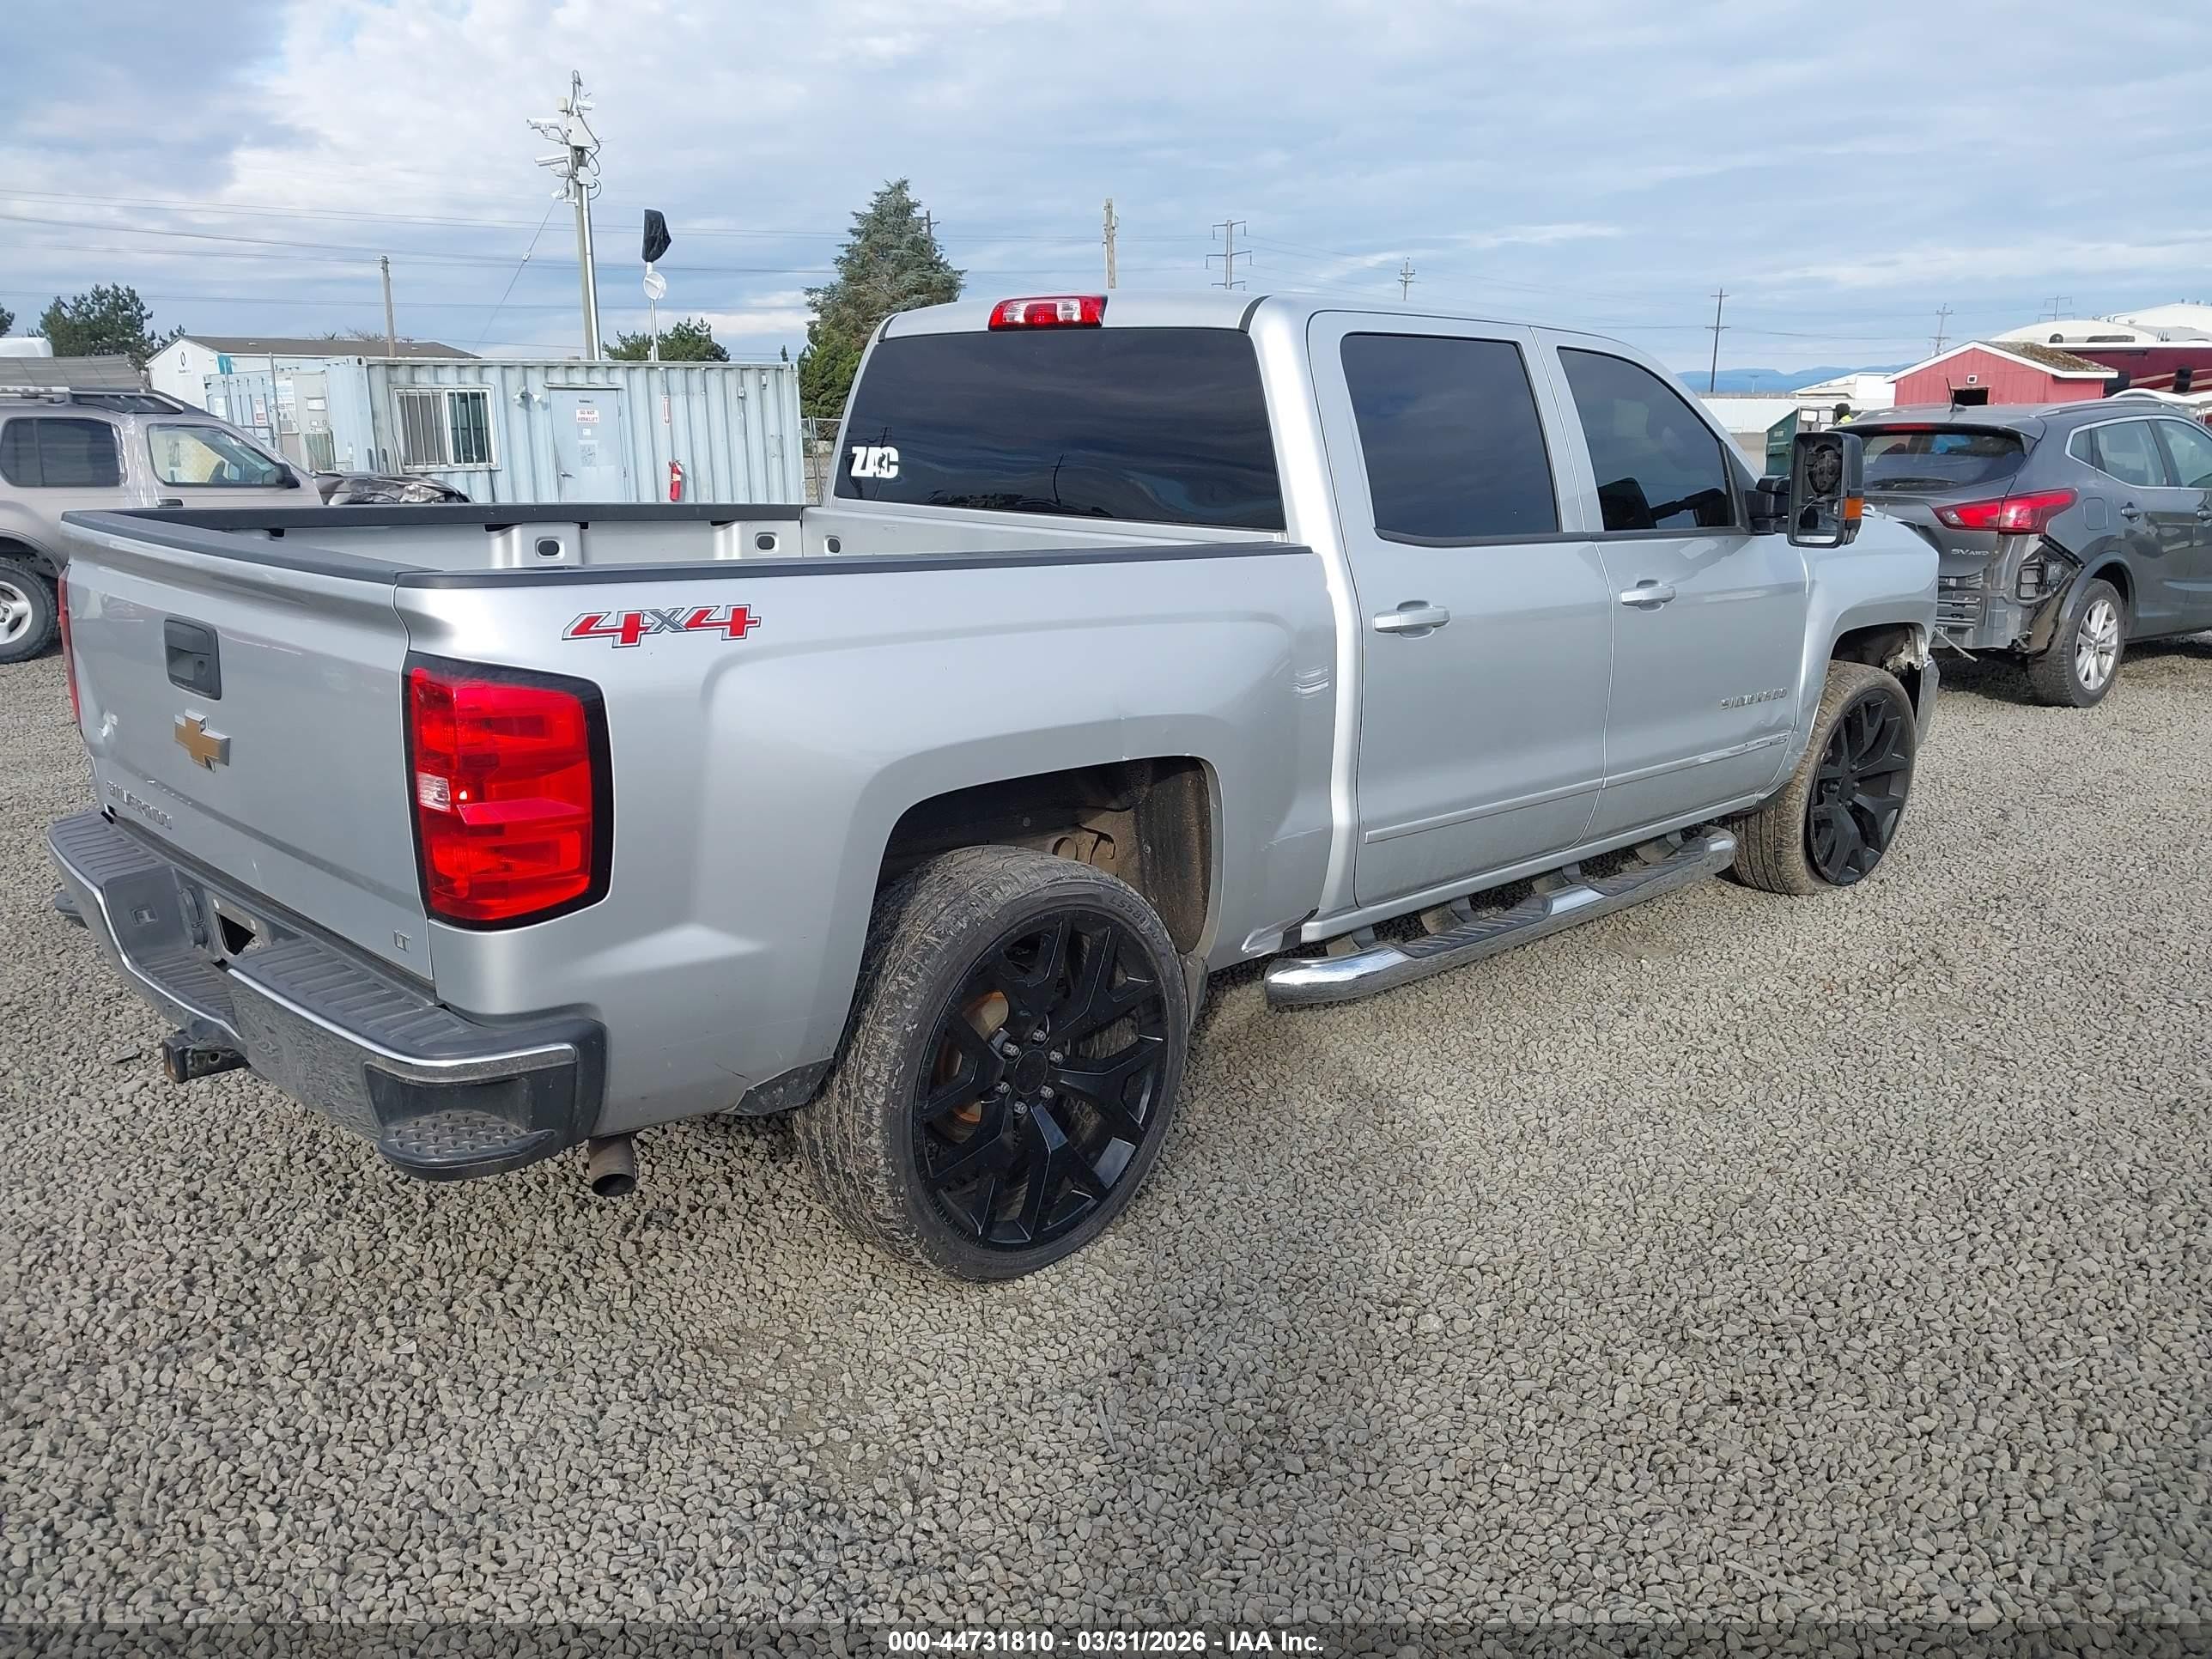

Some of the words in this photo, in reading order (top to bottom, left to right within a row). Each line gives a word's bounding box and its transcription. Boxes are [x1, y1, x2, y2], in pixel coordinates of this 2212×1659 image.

[851, 446, 899, 479] ZAC
[1720, 687, 1788, 710] SILVERADO
[392, 929, 412, 954] LT
